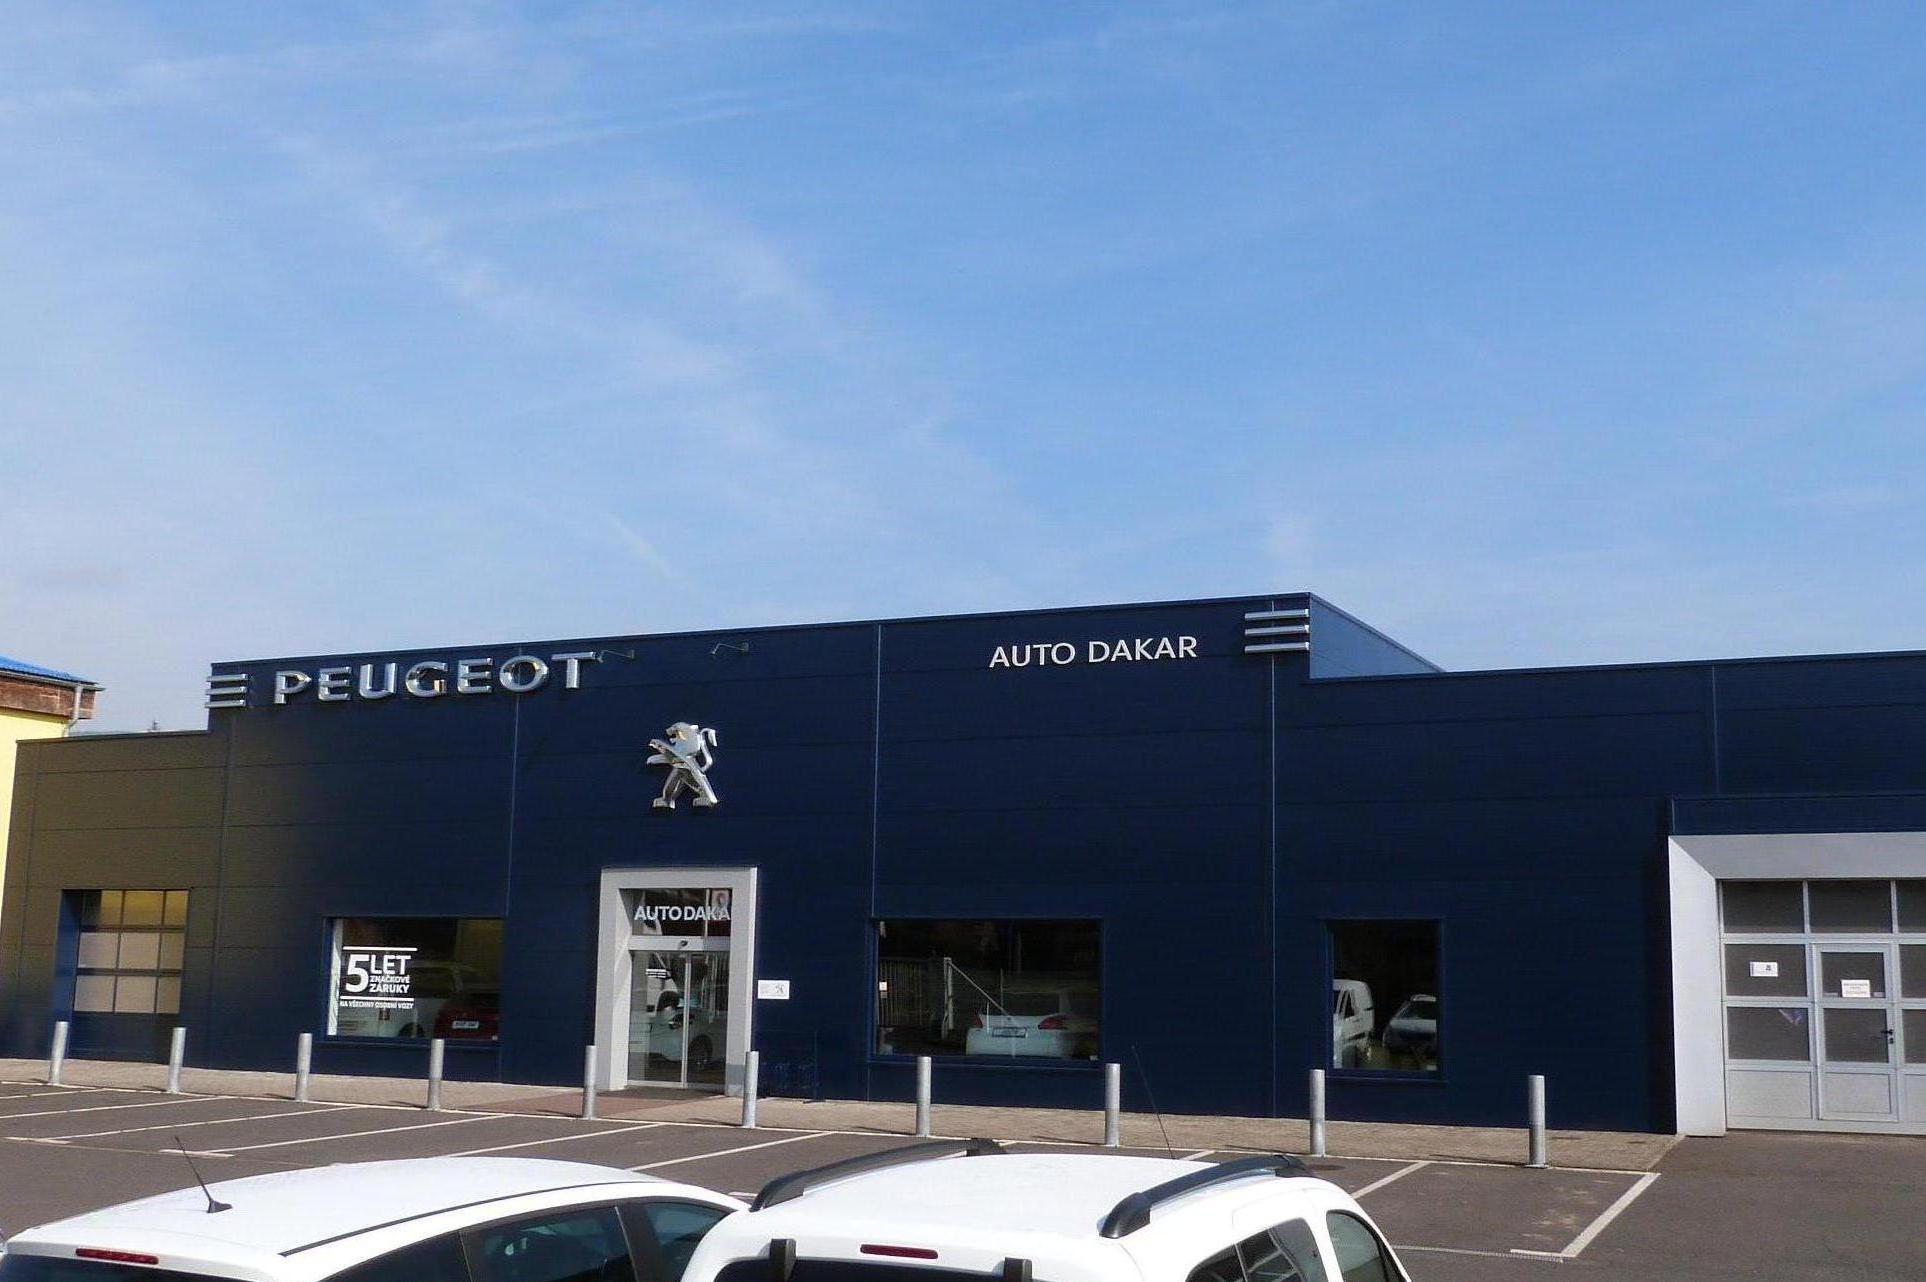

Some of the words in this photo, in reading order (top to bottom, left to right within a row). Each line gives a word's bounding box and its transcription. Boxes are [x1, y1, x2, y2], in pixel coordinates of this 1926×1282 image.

[989, 641, 1076, 668] AUTO
[1088, 635, 1198, 664] DAKAR
[274, 650, 598, 705] PEUGEOT
[634, 905, 682, 921] AUTO
[345, 954, 370, 993] 5
[370, 954, 412, 975] LET
[369, 983, 410, 993] ZÁRUKY
